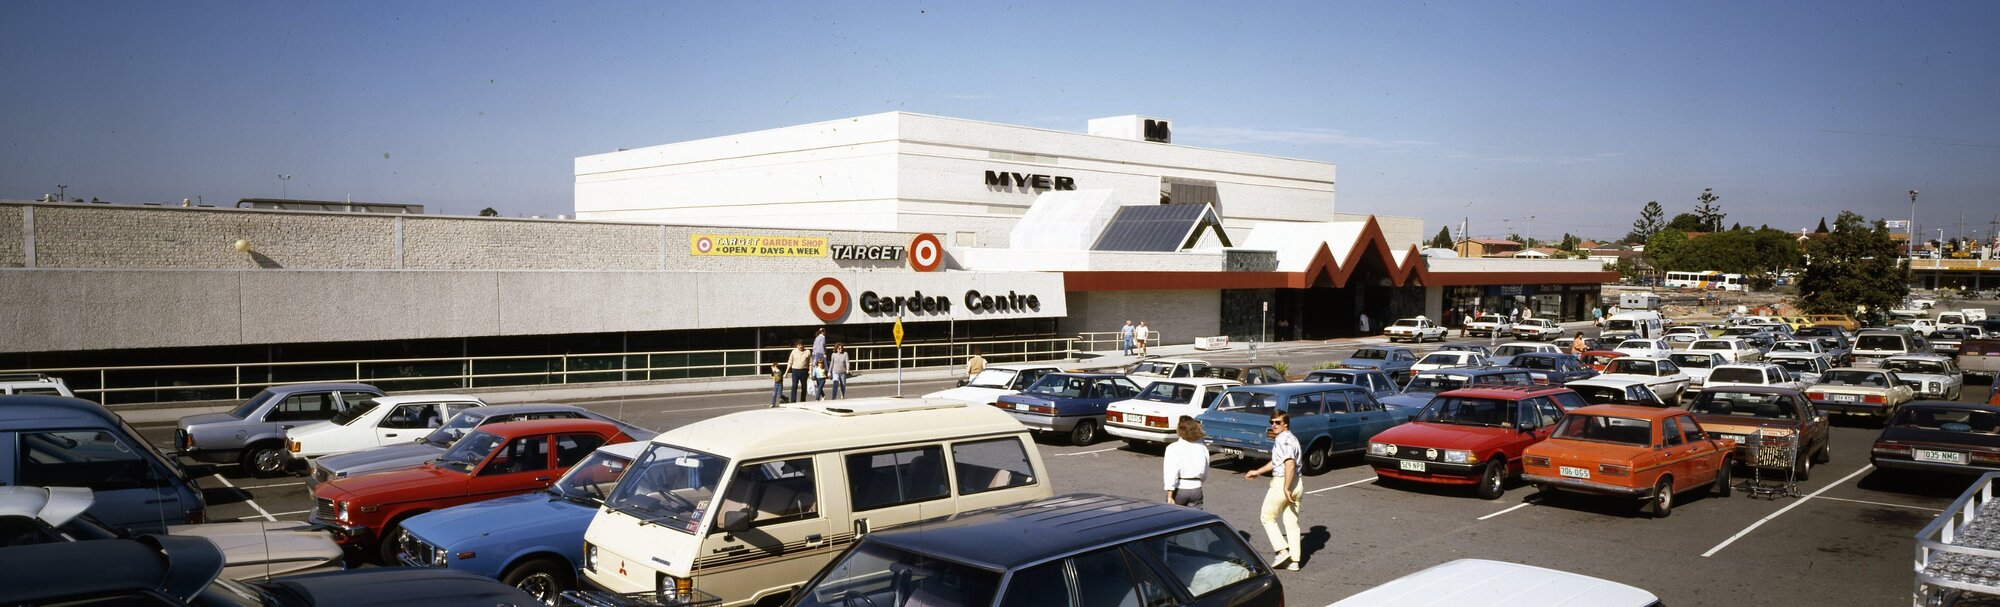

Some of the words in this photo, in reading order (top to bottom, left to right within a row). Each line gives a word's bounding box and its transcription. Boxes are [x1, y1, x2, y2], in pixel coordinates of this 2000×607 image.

[1144, 119, 1168, 140] M
[984, 170, 1075, 191] MYER
[715, 237, 760, 246] TARGET
[762, 238, 799, 247] GARDEN
[801, 238, 824, 248] SHOP
[722, 246, 748, 254] OPEN
[750, 246, 757, 254] 7
[760, 246, 785, 255] DAYS
[787, 247, 794, 255] A
[796, 247, 820, 255] WEEK
[831, 244, 905, 261] TARGET
[859, 290, 951, 314] Garden
[964, 289, 1039, 311] Centre
